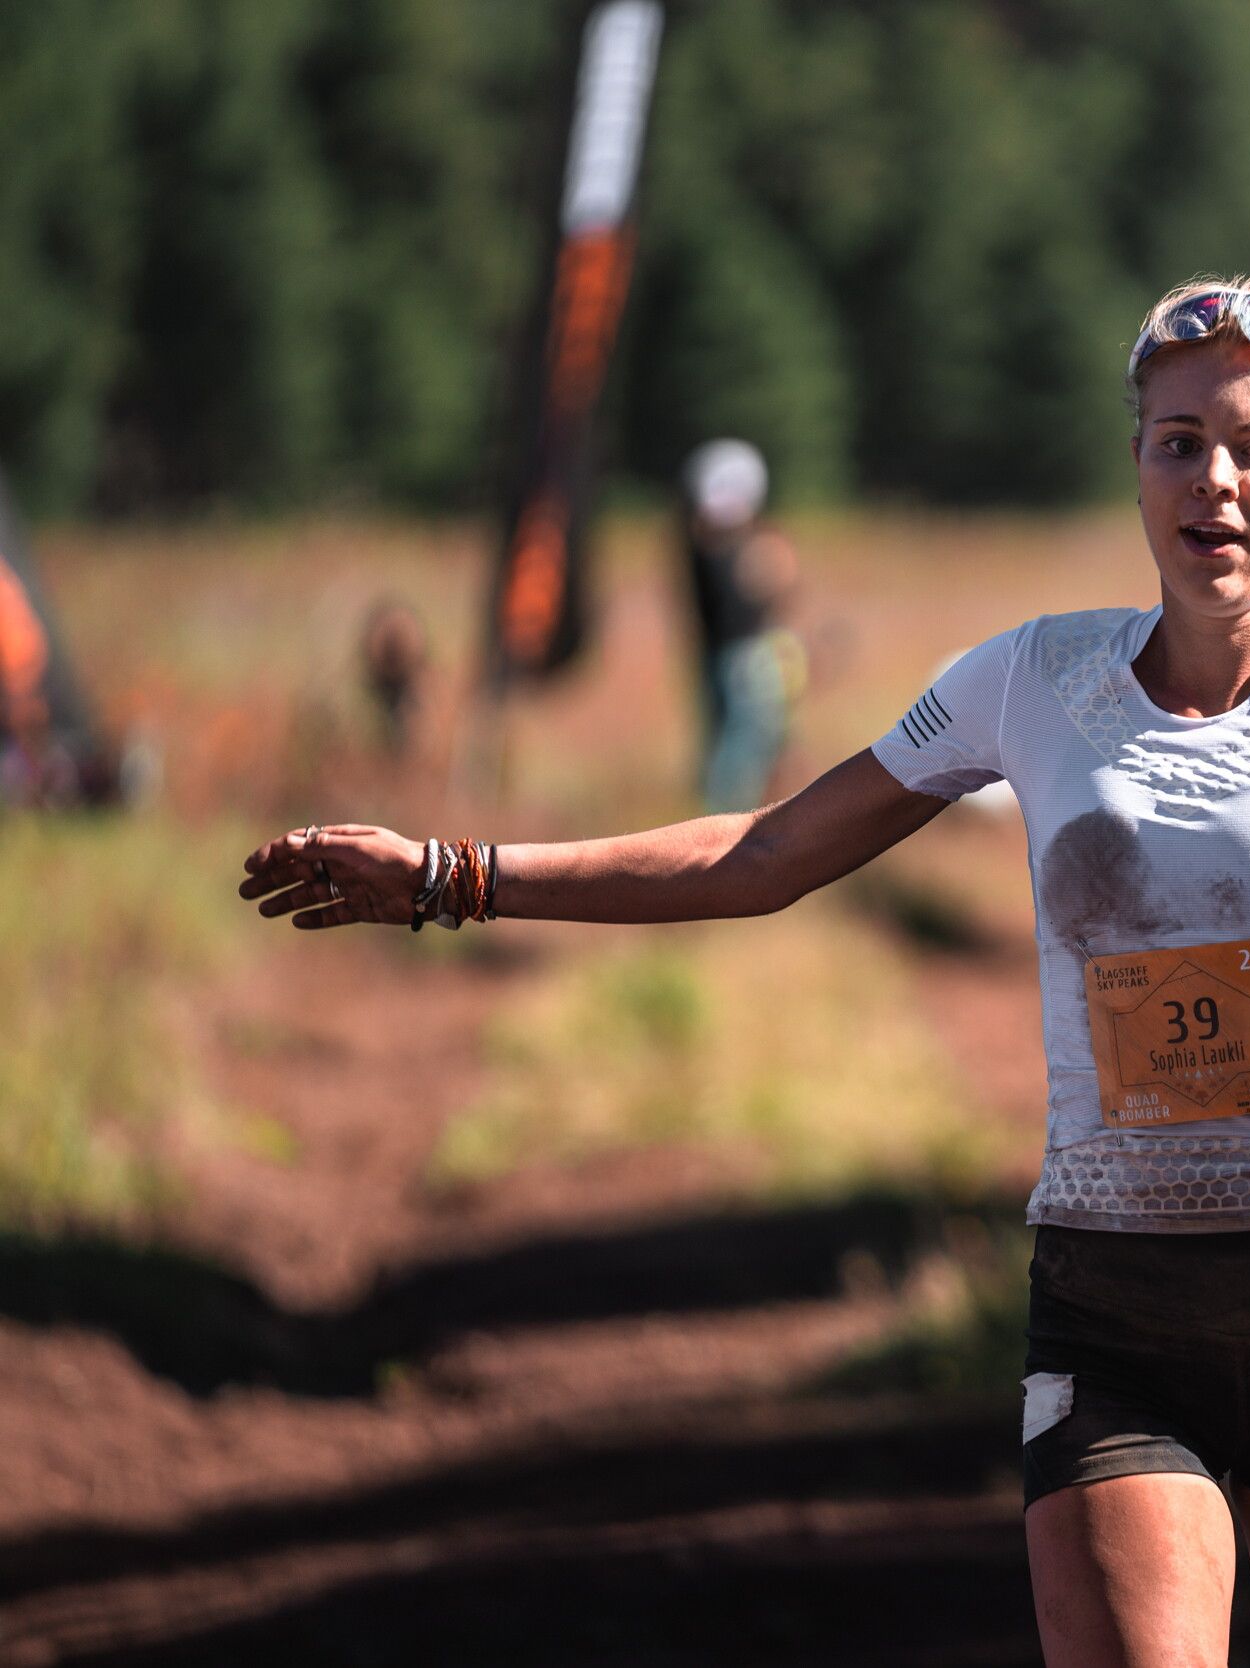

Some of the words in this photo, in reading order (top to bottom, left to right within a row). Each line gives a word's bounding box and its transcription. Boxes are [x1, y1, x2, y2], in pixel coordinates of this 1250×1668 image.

[1097, 980, 1114, 991] SKY
[1118, 976, 1150, 989] PEAKS
[1163, 996, 1220, 1044] 39
[1150, 1048, 1197, 1075] Sophia
[1201, 1040, 1245, 1065] Laukli
[1125, 1093, 1159, 1108] QUAD
[1119, 1105, 1170, 1121] BOMBER
